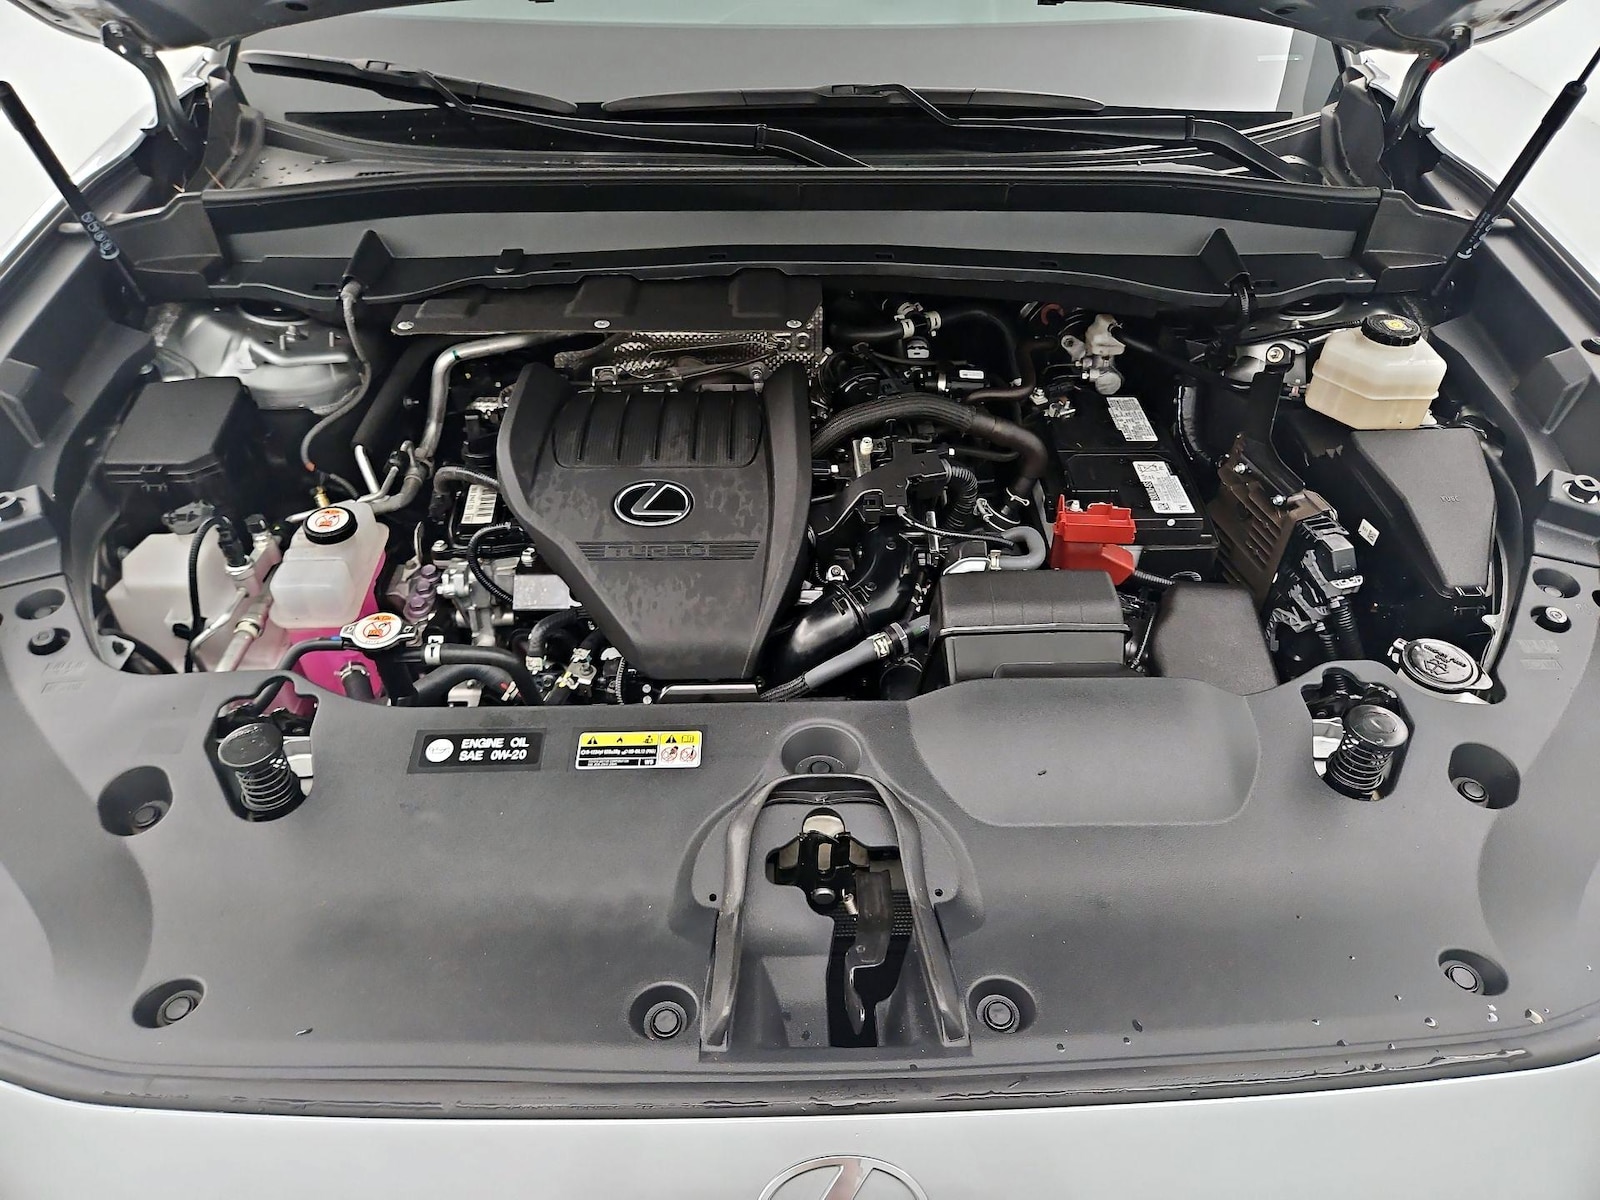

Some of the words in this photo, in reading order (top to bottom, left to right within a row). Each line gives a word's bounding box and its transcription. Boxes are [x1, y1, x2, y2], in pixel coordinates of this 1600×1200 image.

[605, 545, 710, 558] TURBO
[461, 738, 505, 749] ENGINE
[510, 737, 530, 748] OIL
[459, 750, 484, 761] SAE
